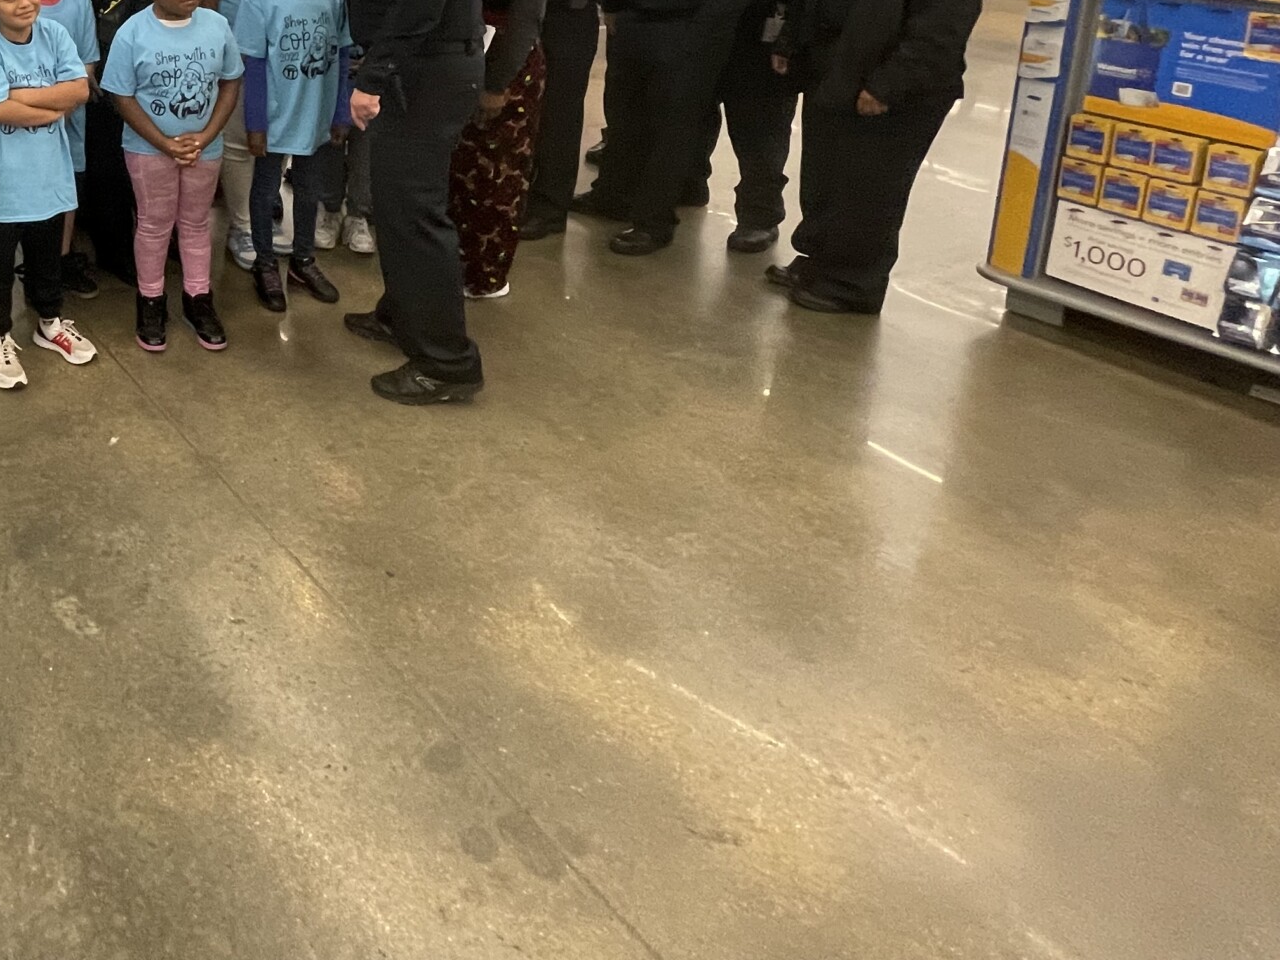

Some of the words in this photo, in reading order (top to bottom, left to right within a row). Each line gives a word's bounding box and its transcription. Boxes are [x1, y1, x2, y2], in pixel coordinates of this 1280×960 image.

[283, 15, 309, 31] Shop
[154, 50, 180, 68] Shop
[183, 46, 207, 61] with
[8, 68, 32, 87] Shop
[1064, 236, 1146, 278] $1,000
